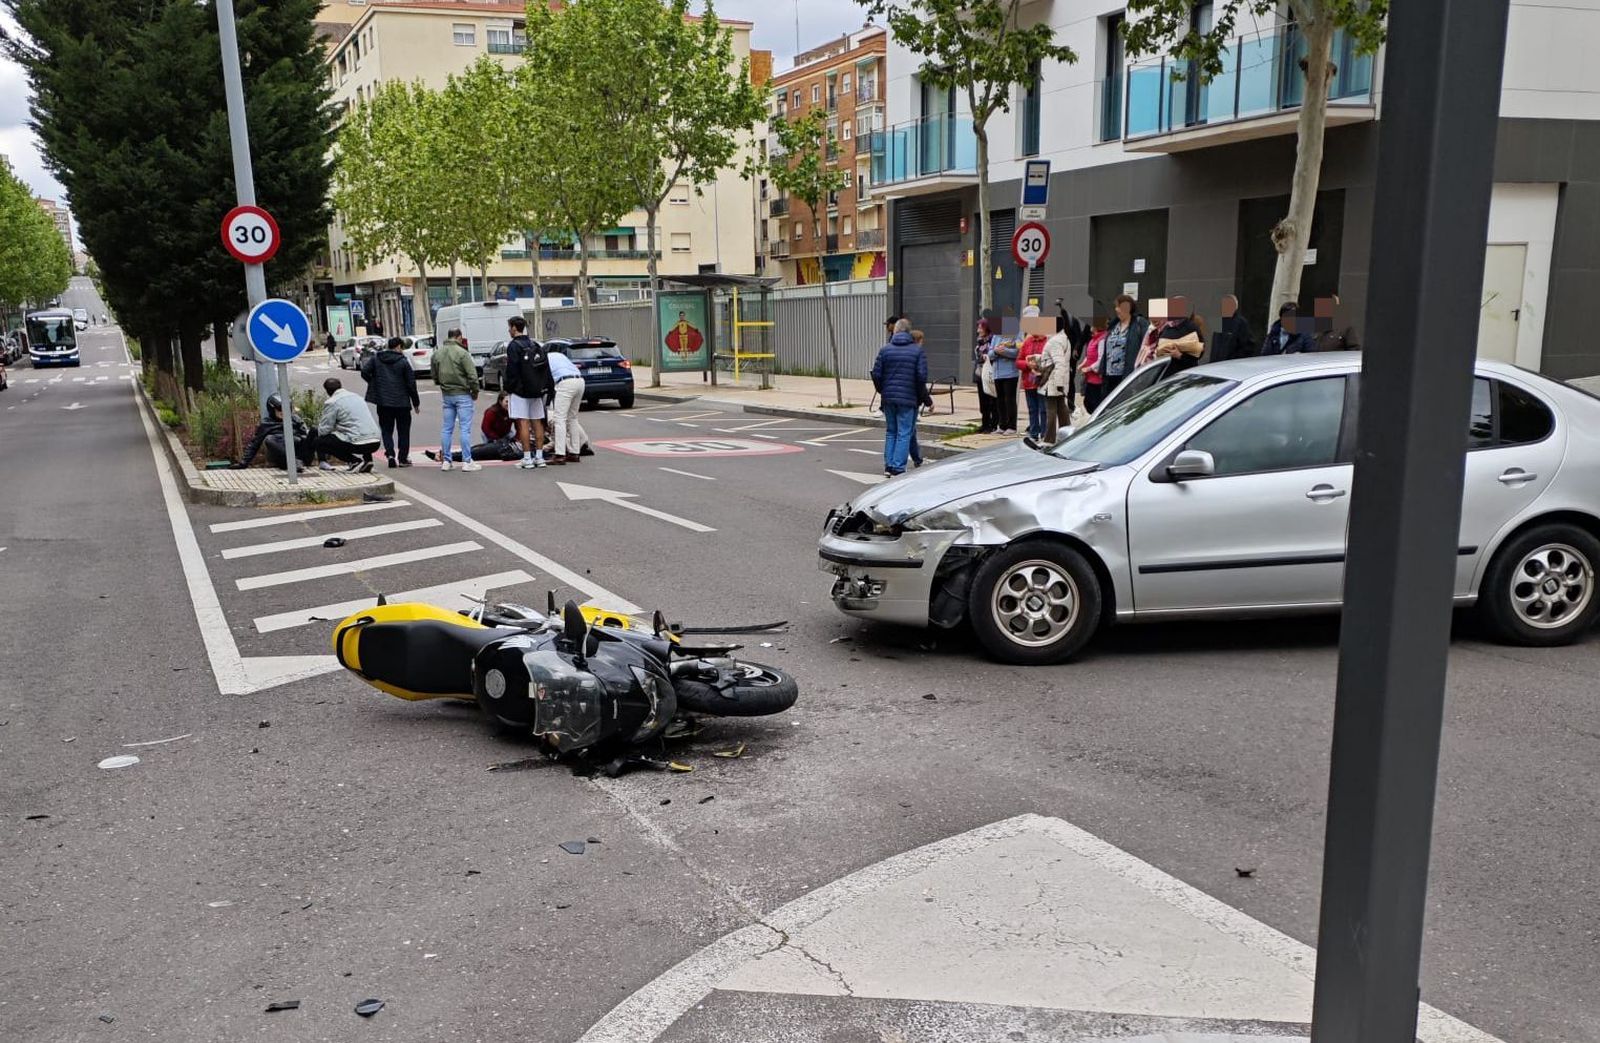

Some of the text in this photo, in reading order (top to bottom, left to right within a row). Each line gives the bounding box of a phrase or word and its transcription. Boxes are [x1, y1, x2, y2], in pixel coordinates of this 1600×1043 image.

[235, 225, 266, 244] 30
[1021, 237, 1042, 253] 30
[643, 441, 749, 452] 30
